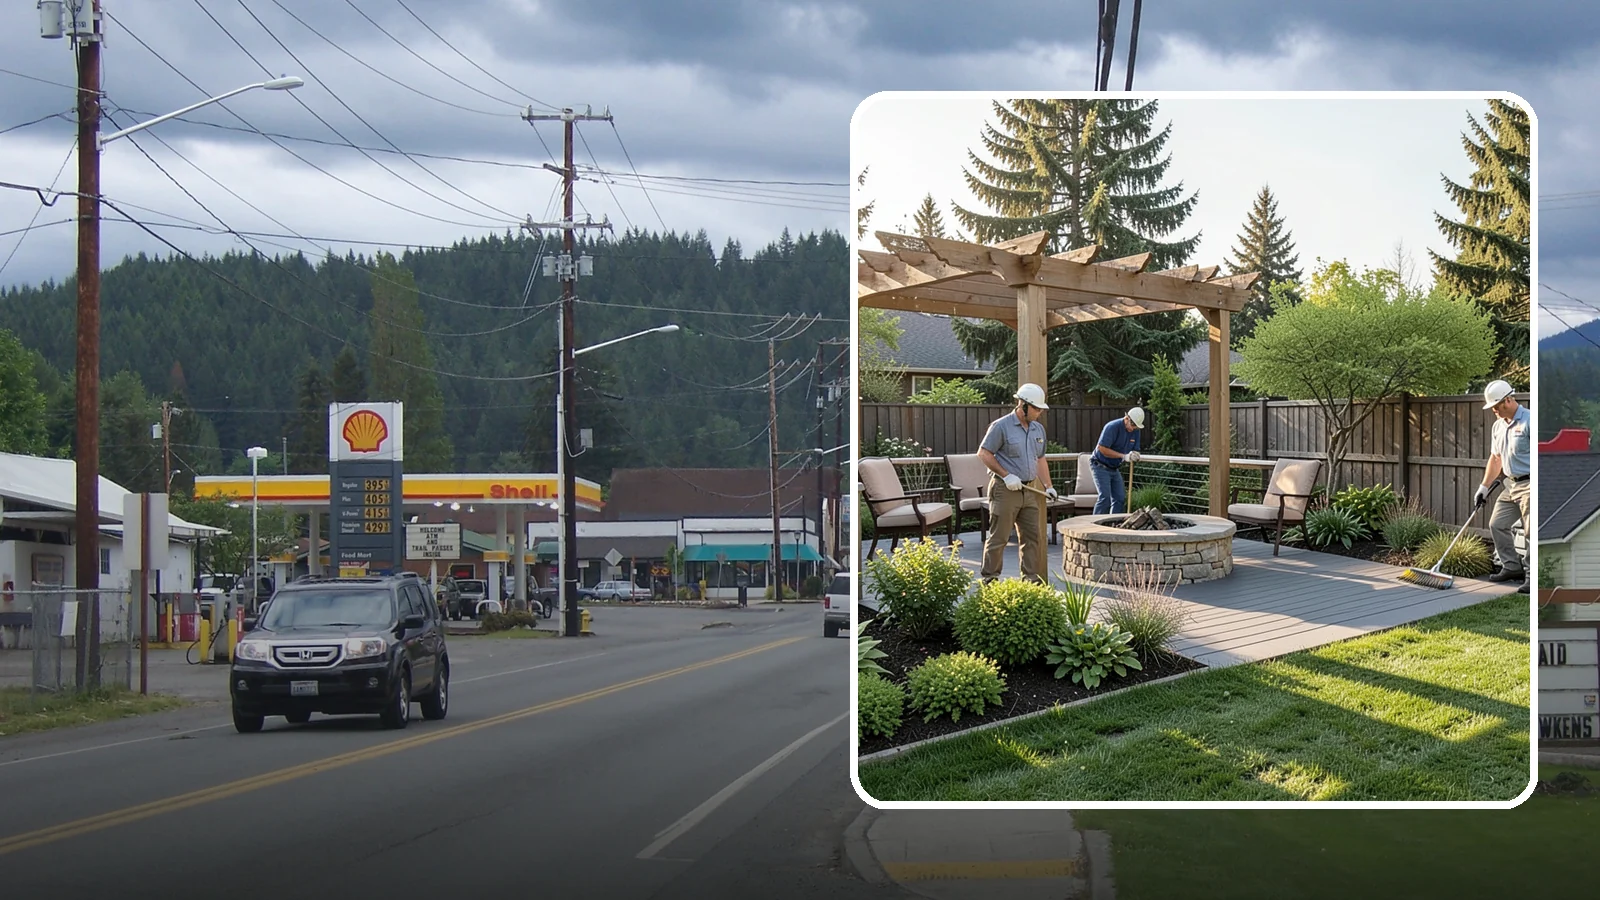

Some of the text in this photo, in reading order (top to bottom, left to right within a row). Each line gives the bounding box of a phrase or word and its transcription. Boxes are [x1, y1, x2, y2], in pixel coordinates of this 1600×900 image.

[366, 480, 383, 490] 395
[490, 484, 547, 499] Shell
[366, 494, 383, 504] 405
[366, 508, 383, 517] 415
[366, 523, 383, 532] 429
